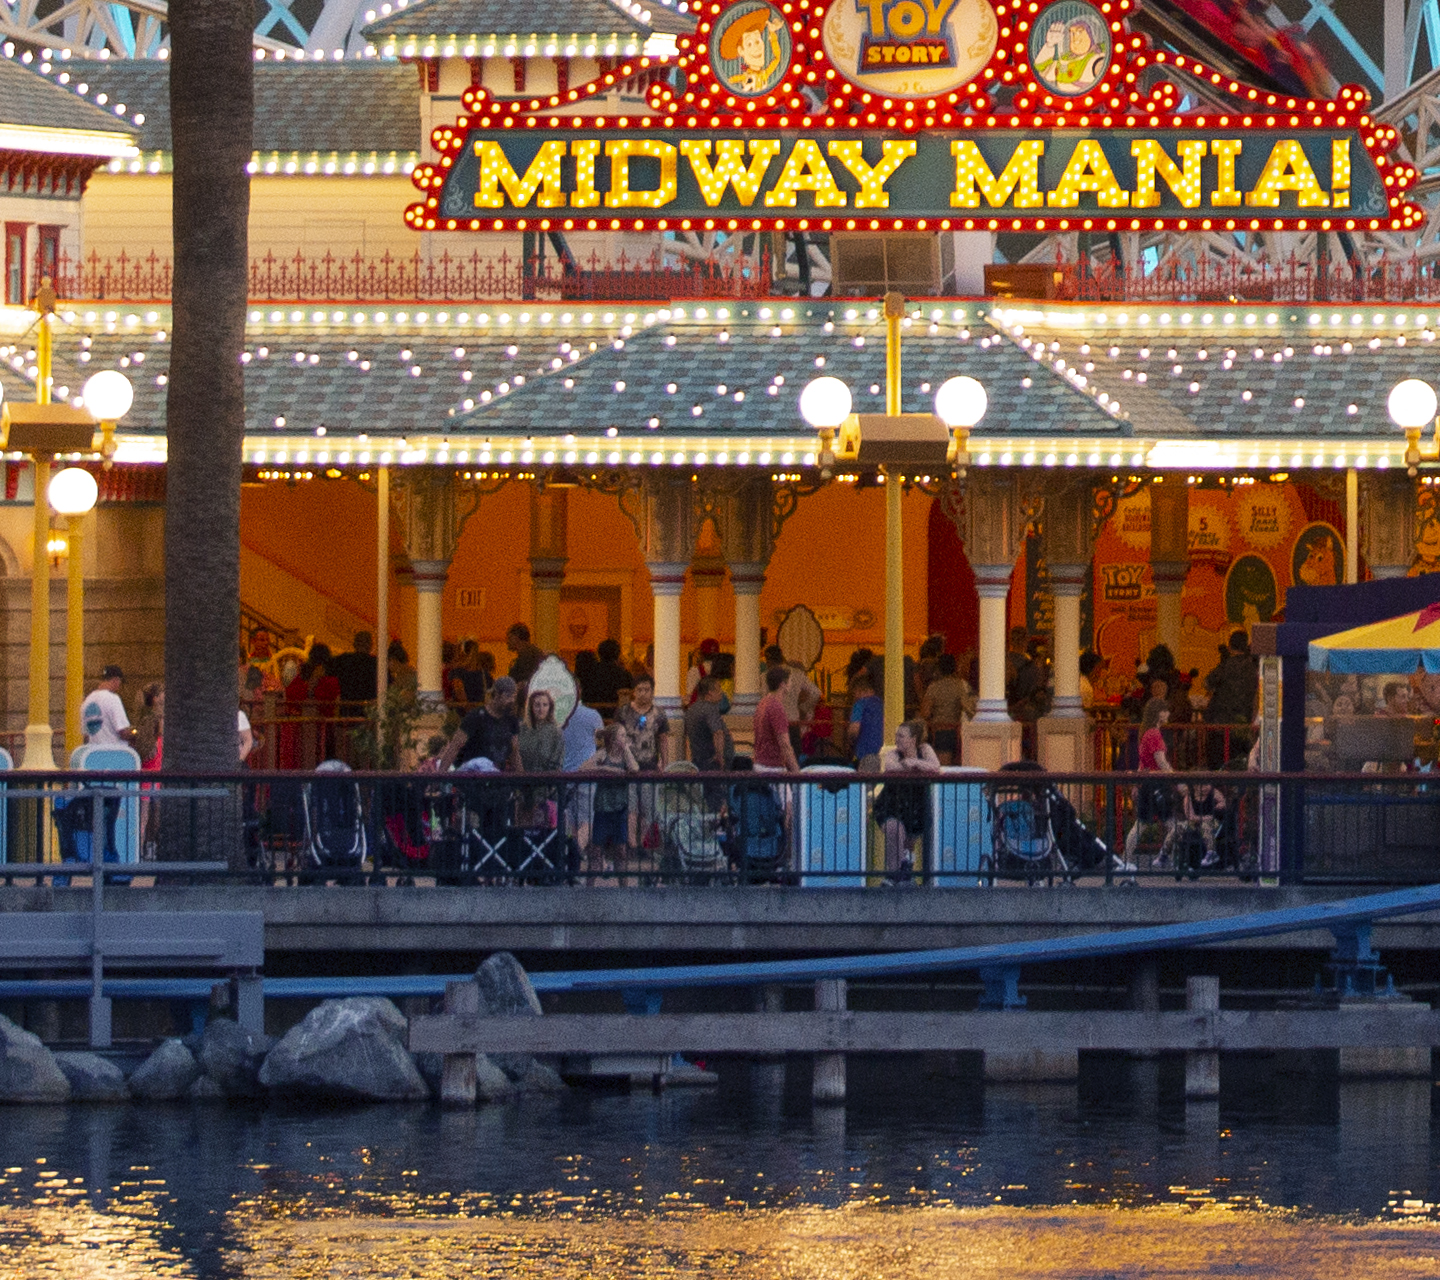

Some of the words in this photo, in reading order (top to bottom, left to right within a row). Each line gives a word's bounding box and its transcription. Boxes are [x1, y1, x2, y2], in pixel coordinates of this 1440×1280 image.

[867, 45, 944, 64] STORY
[474, 140, 917, 209] MIDWAY
[950, 140, 1352, 209] MANIA!
[1101, 565, 1147, 586] TOY
